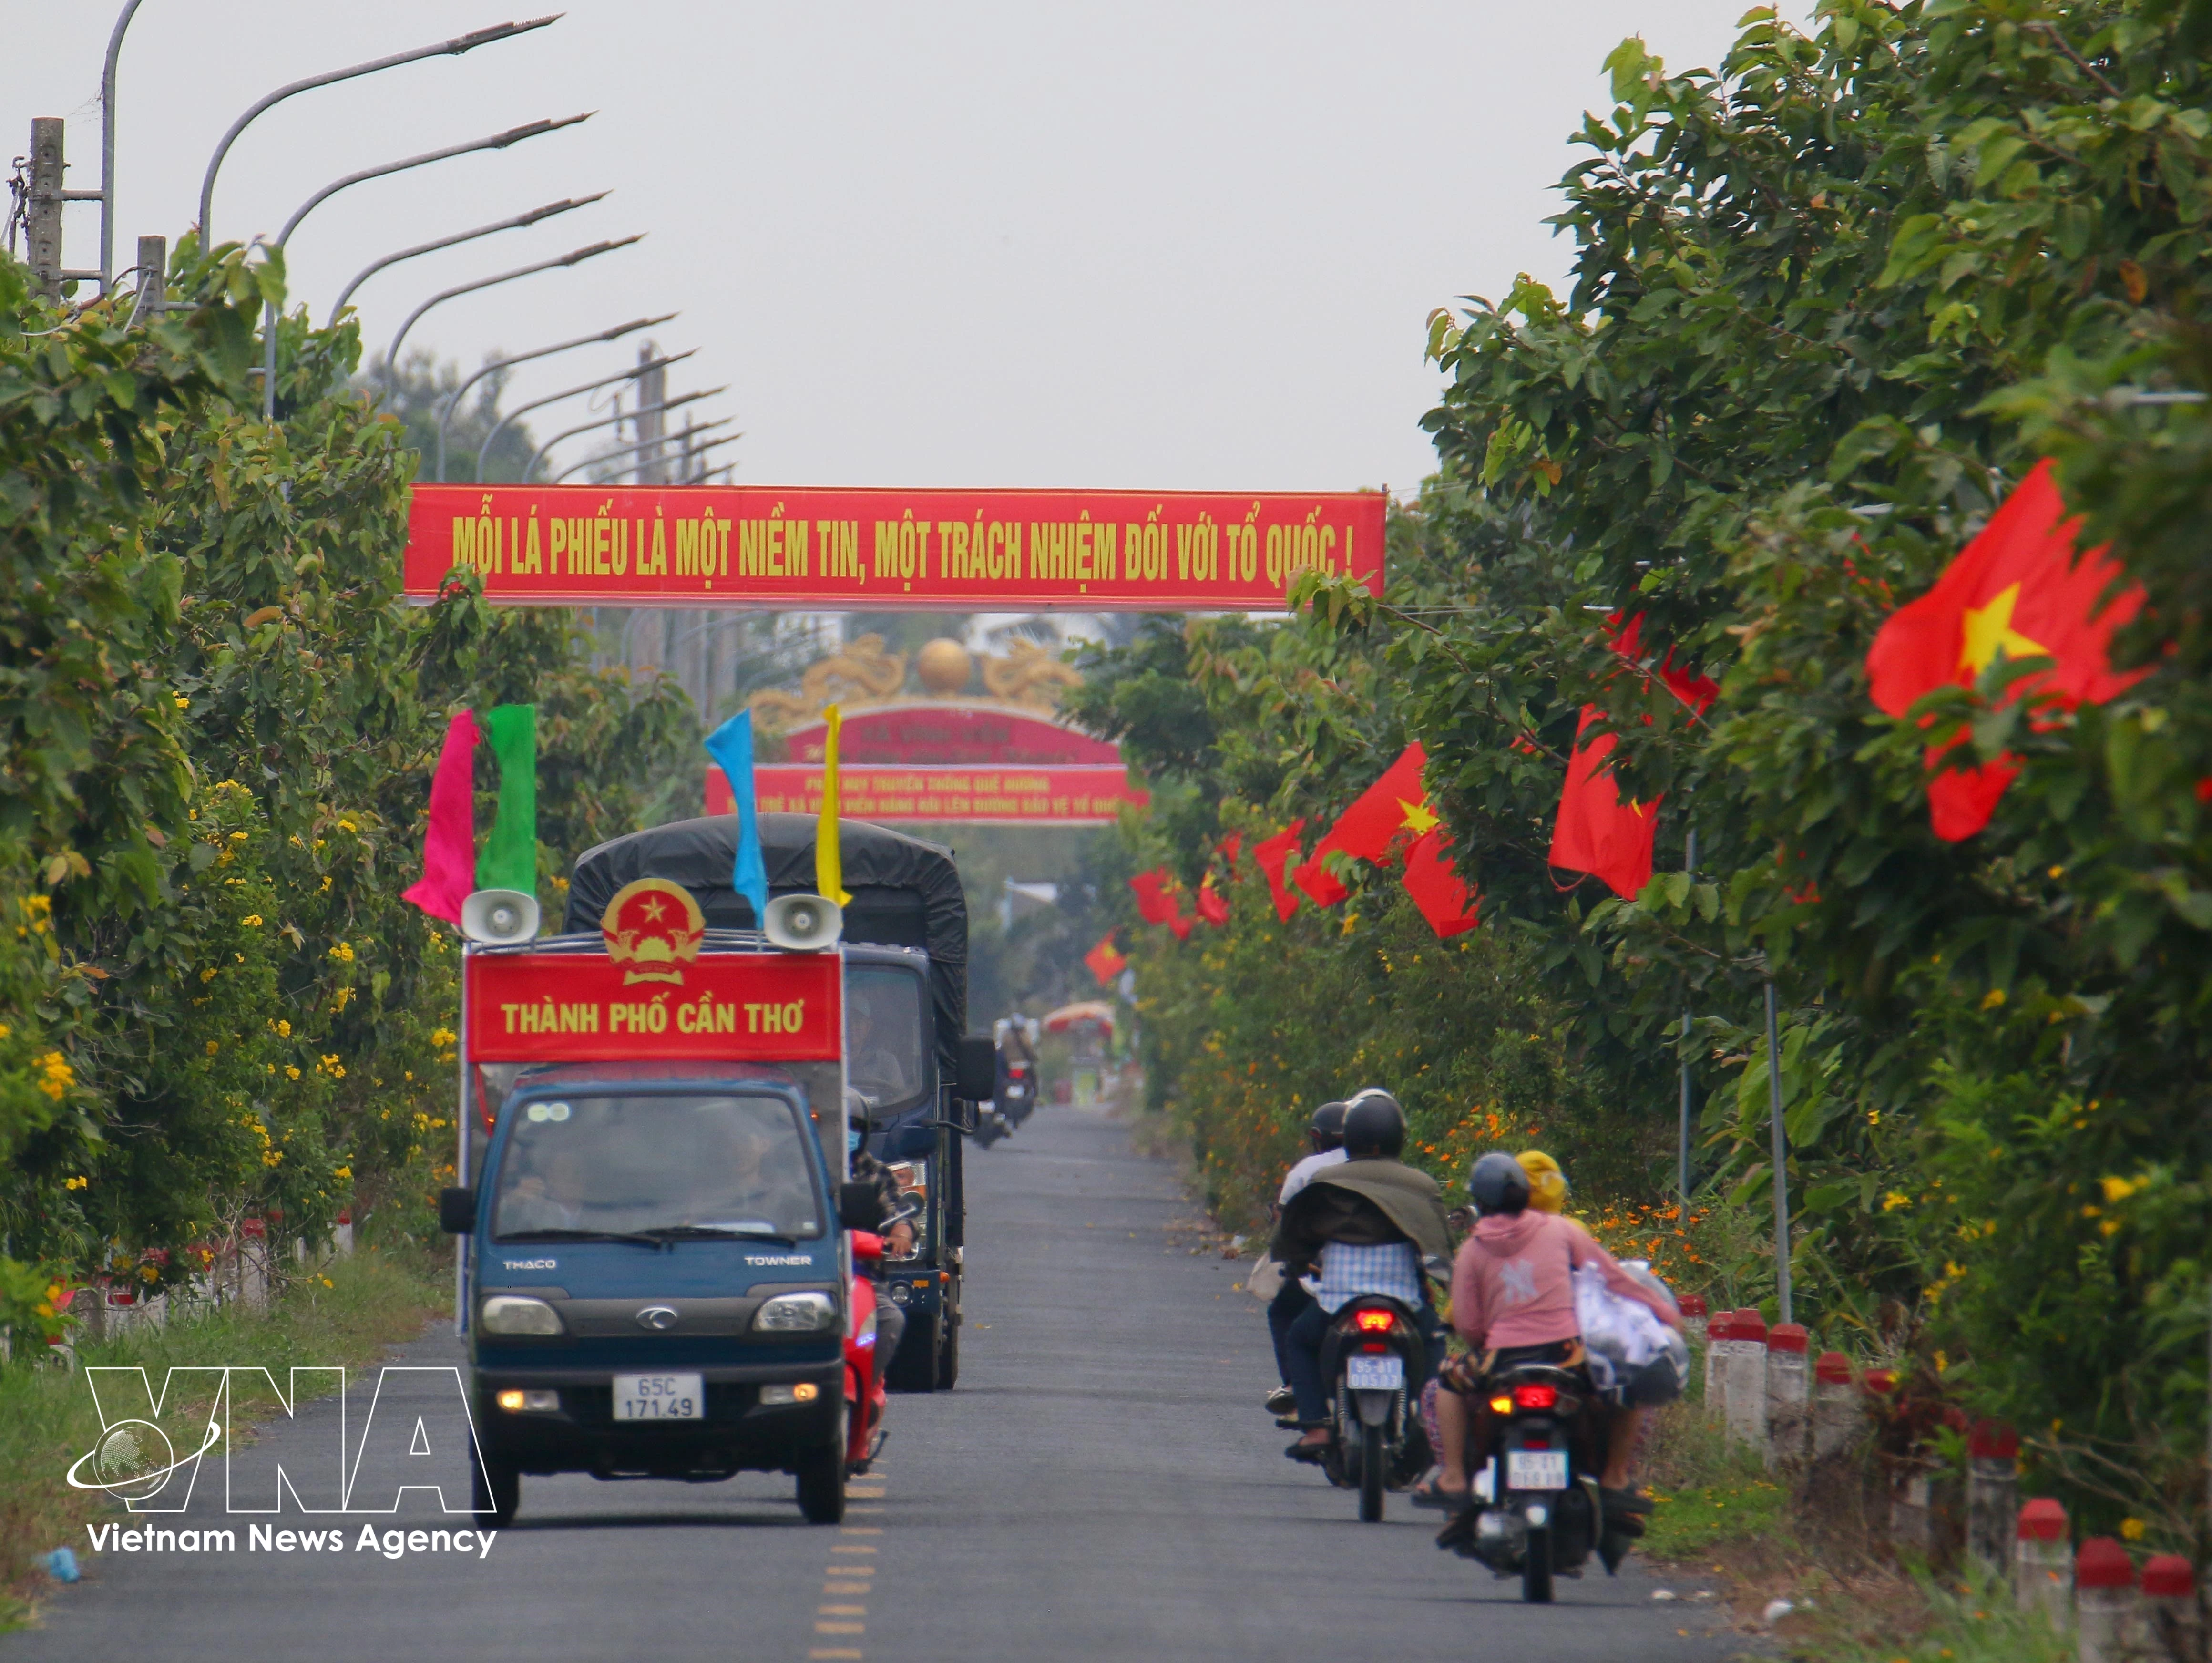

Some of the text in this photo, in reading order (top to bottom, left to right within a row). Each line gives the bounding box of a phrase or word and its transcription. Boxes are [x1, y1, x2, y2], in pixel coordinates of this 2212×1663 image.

[453, 493, 502, 575] MỖI
[511, 504, 542, 574] LÁ
[550, 499, 627, 575] PHIẾU
[636, 506, 667, 575] LÀ
[676, 506, 731, 589] MỘT
[739, 502, 808, 576] NIỀM
[817, 520, 866, 585] TIN,
[875, 508, 931, 592] MỘT
[938, 509, 1022, 579] TRÁCH
[1030, 510, 1117, 593] NHIỆM
[1124, 504, 1168, 581] ĐỐI
[1177, 512, 1219, 581] VỚI
[1226, 501, 1260, 582] TỔ
[1266, 505, 1336, 588] QUỐC
[501, 990, 804, 1034] THÀNH PHỐ CẦN THƠ
[503, 1259, 556, 1270] THACO
[744, 1255, 812, 1266] TOWNER
[638, 1377, 676, 1396] 65C
[625, 1398, 693, 1418] 171.49
